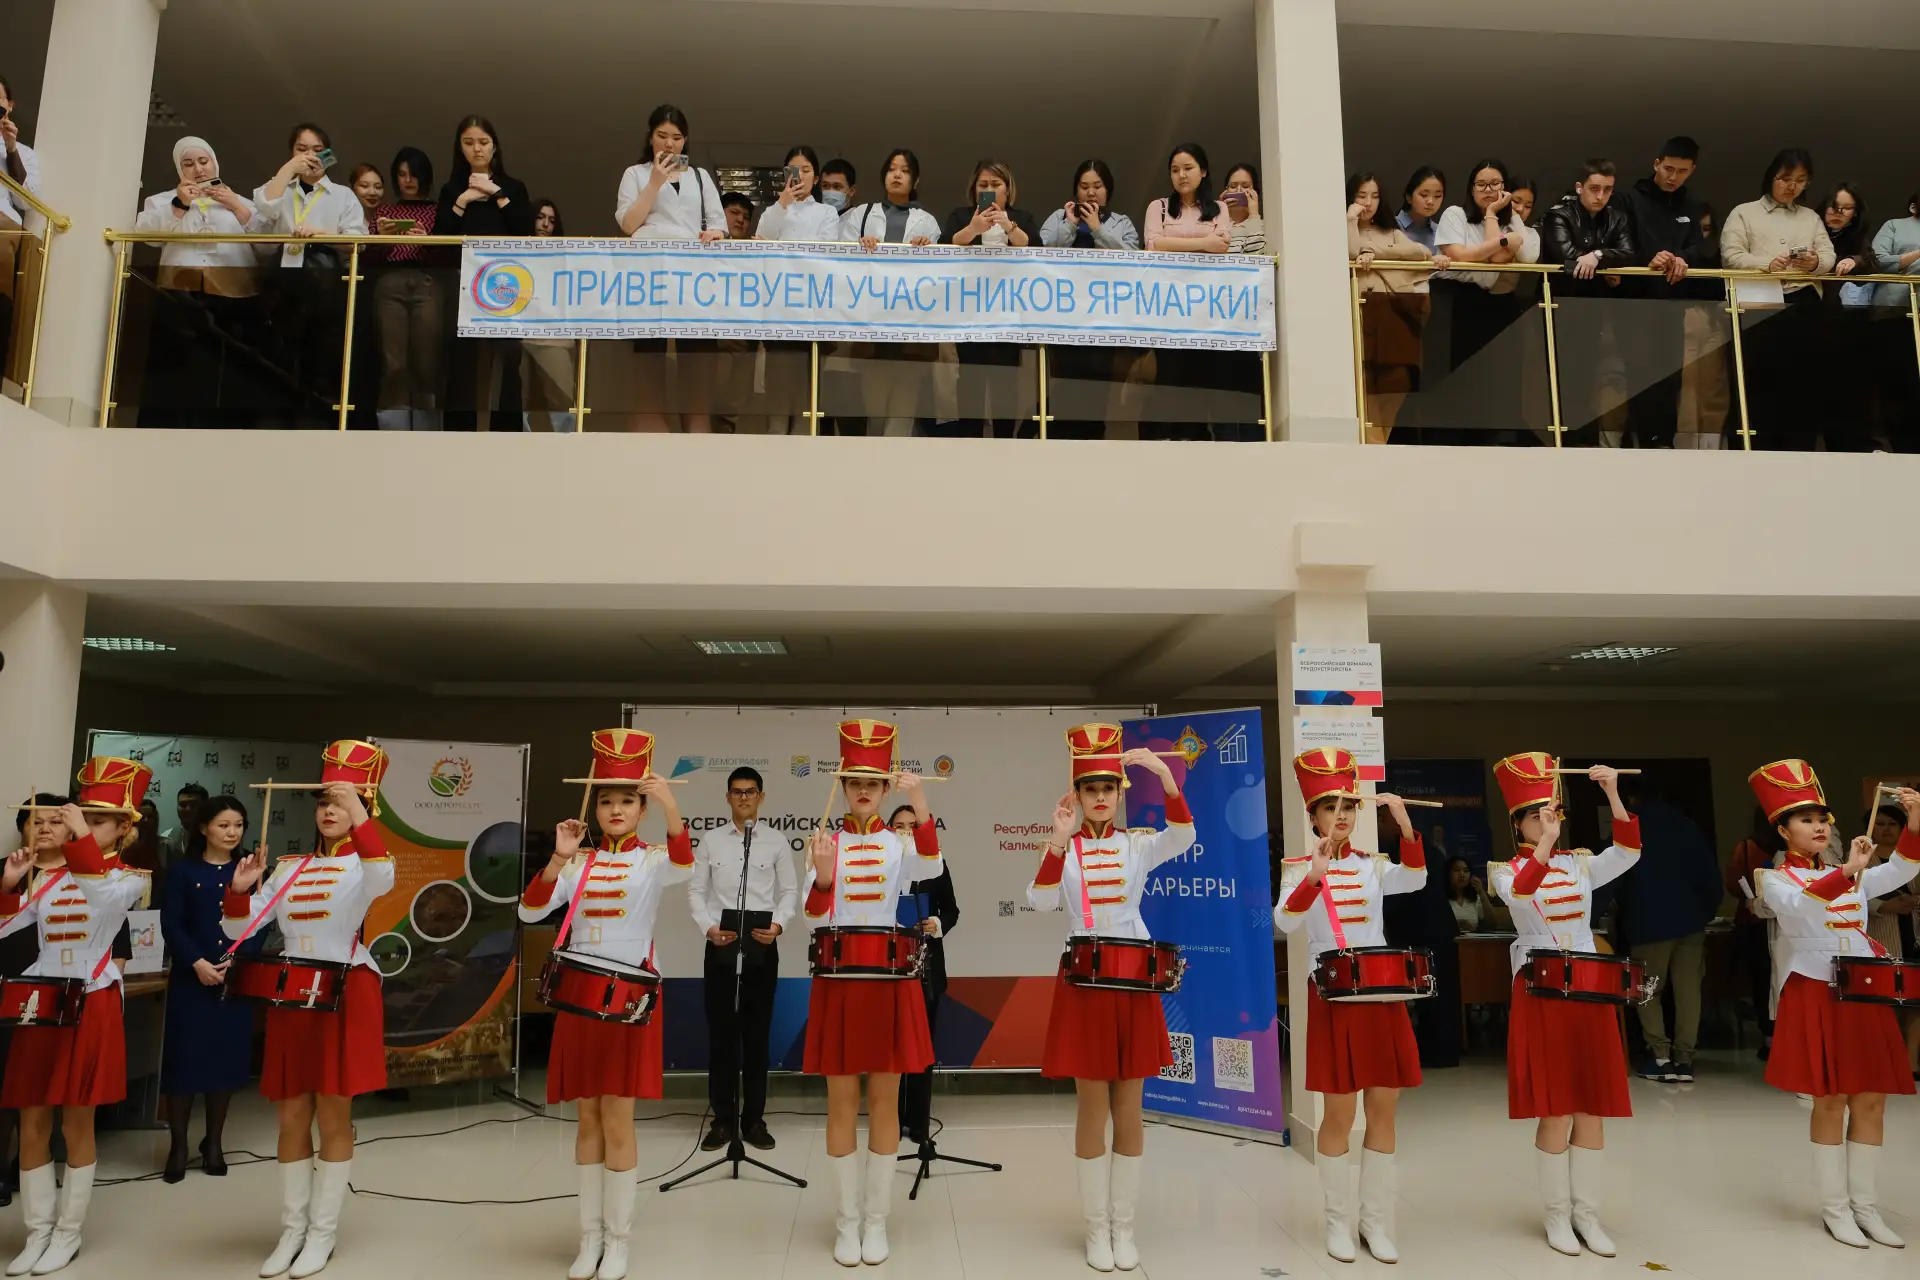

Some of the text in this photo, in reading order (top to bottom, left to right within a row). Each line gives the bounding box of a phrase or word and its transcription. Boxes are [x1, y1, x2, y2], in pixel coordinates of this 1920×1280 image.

[552, 270, 1260, 321] ПРИВЕТСТВУЕМ УЧАСТНИКОВ ЯРМАРКИ!
[708, 757, 769, 766] ДЕМОГРАФИЯ
[994, 823, 1055, 836] Республи
